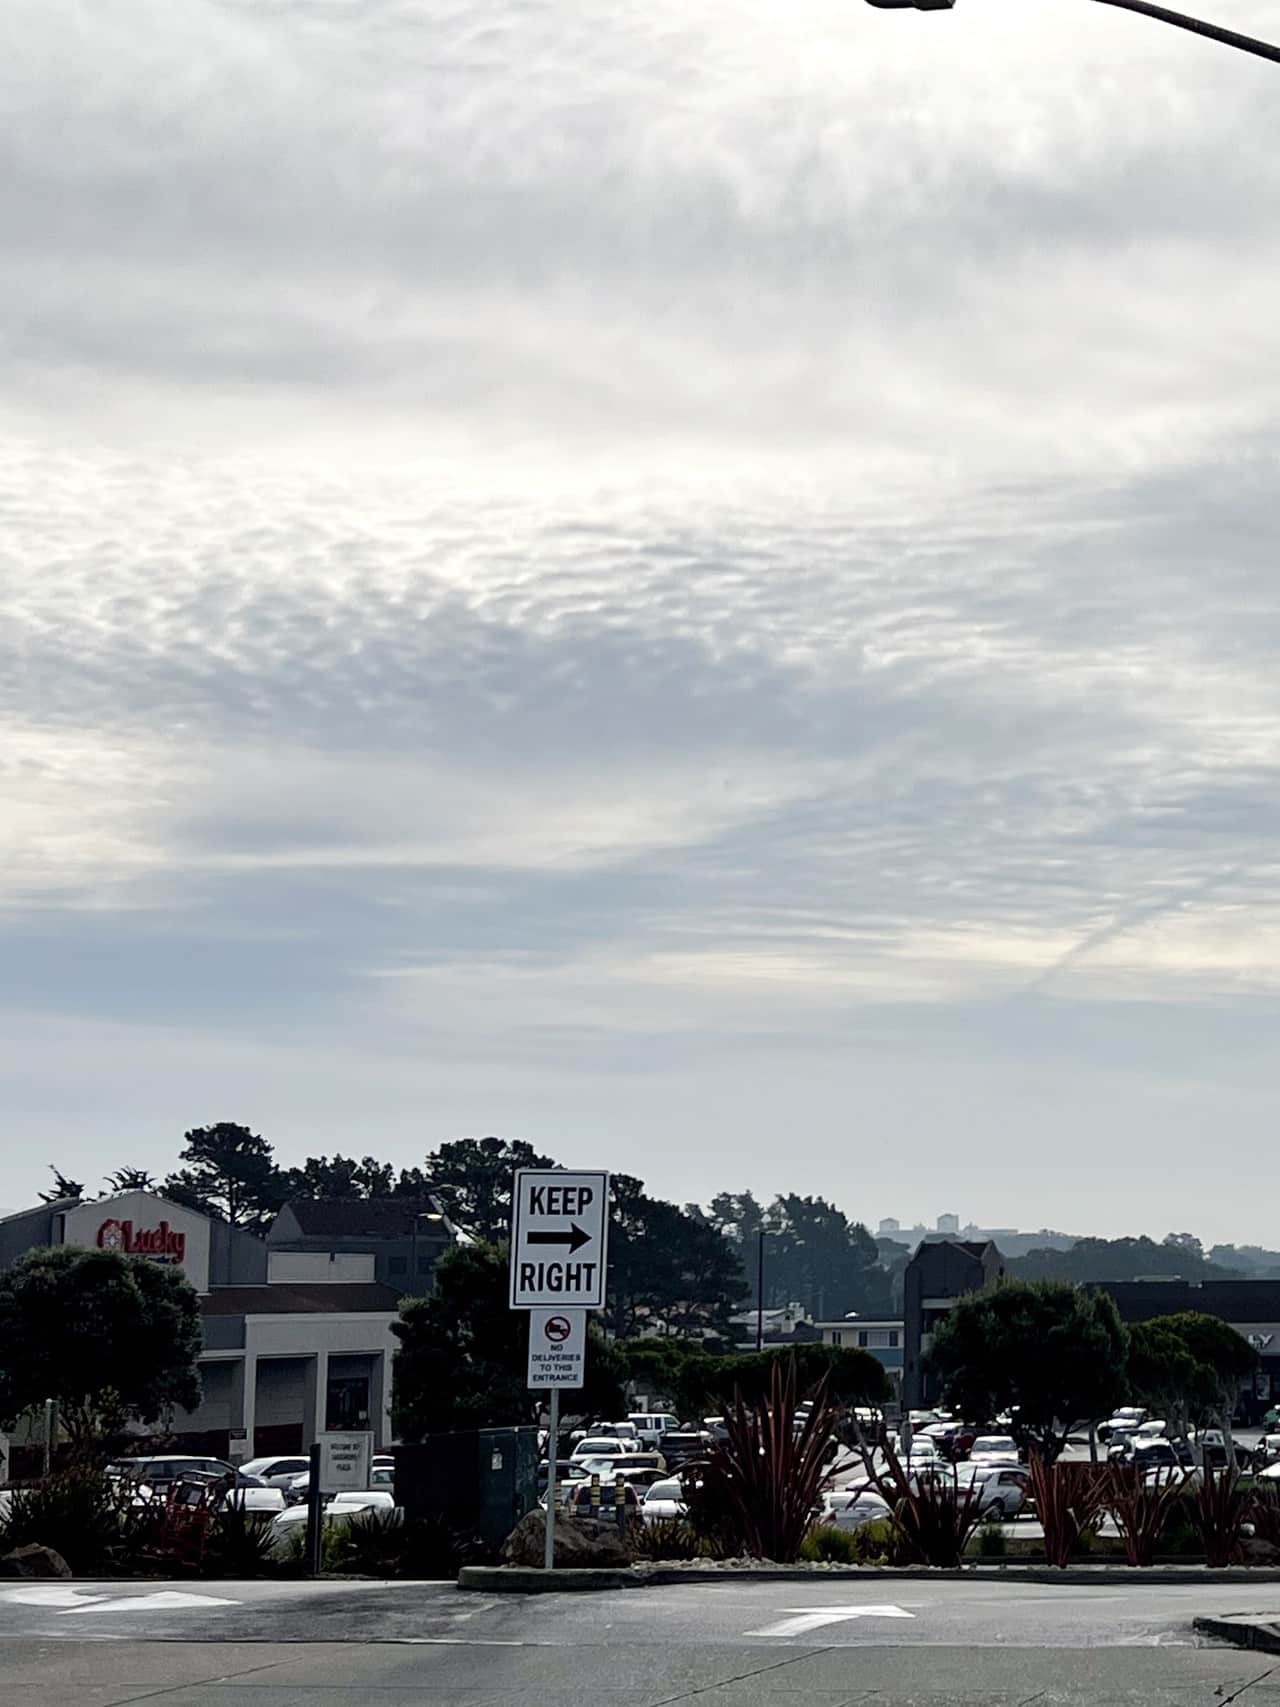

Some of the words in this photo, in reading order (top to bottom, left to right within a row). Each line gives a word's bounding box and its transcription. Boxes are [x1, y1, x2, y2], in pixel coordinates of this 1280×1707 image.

[529, 1186, 593, 1216] KEEP
[121, 1220, 186, 1265] Lucky
[520, 1262, 597, 1292] RIGHT
